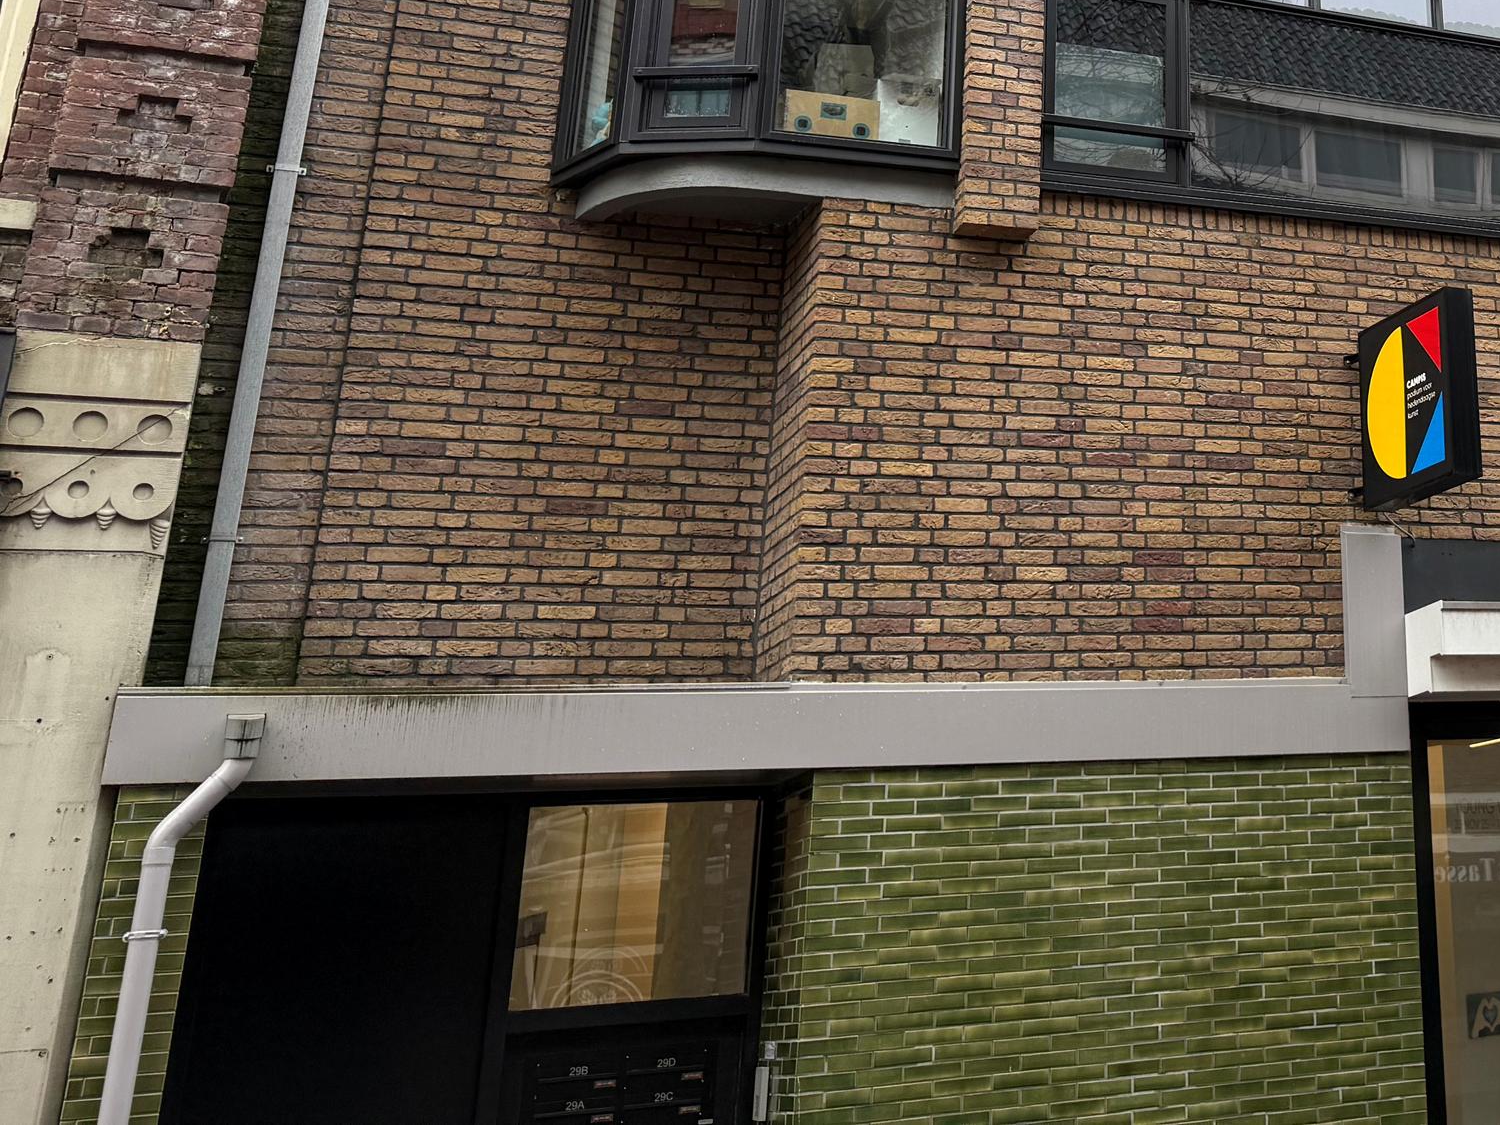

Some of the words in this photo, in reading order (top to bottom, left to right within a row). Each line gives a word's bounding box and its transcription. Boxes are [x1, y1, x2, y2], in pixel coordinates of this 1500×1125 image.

[1406, 372, 1427, 389] CAMPIS
[1406, 387, 1423, 401] podium
[1423, 382, 1433, 392] voor
[569, 1065, 589, 1076] 29B
[656, 1057, 677, 1068] 29D
[565, 1101, 585, 1111] 29A
[654, 1091, 674, 1102] 29C
